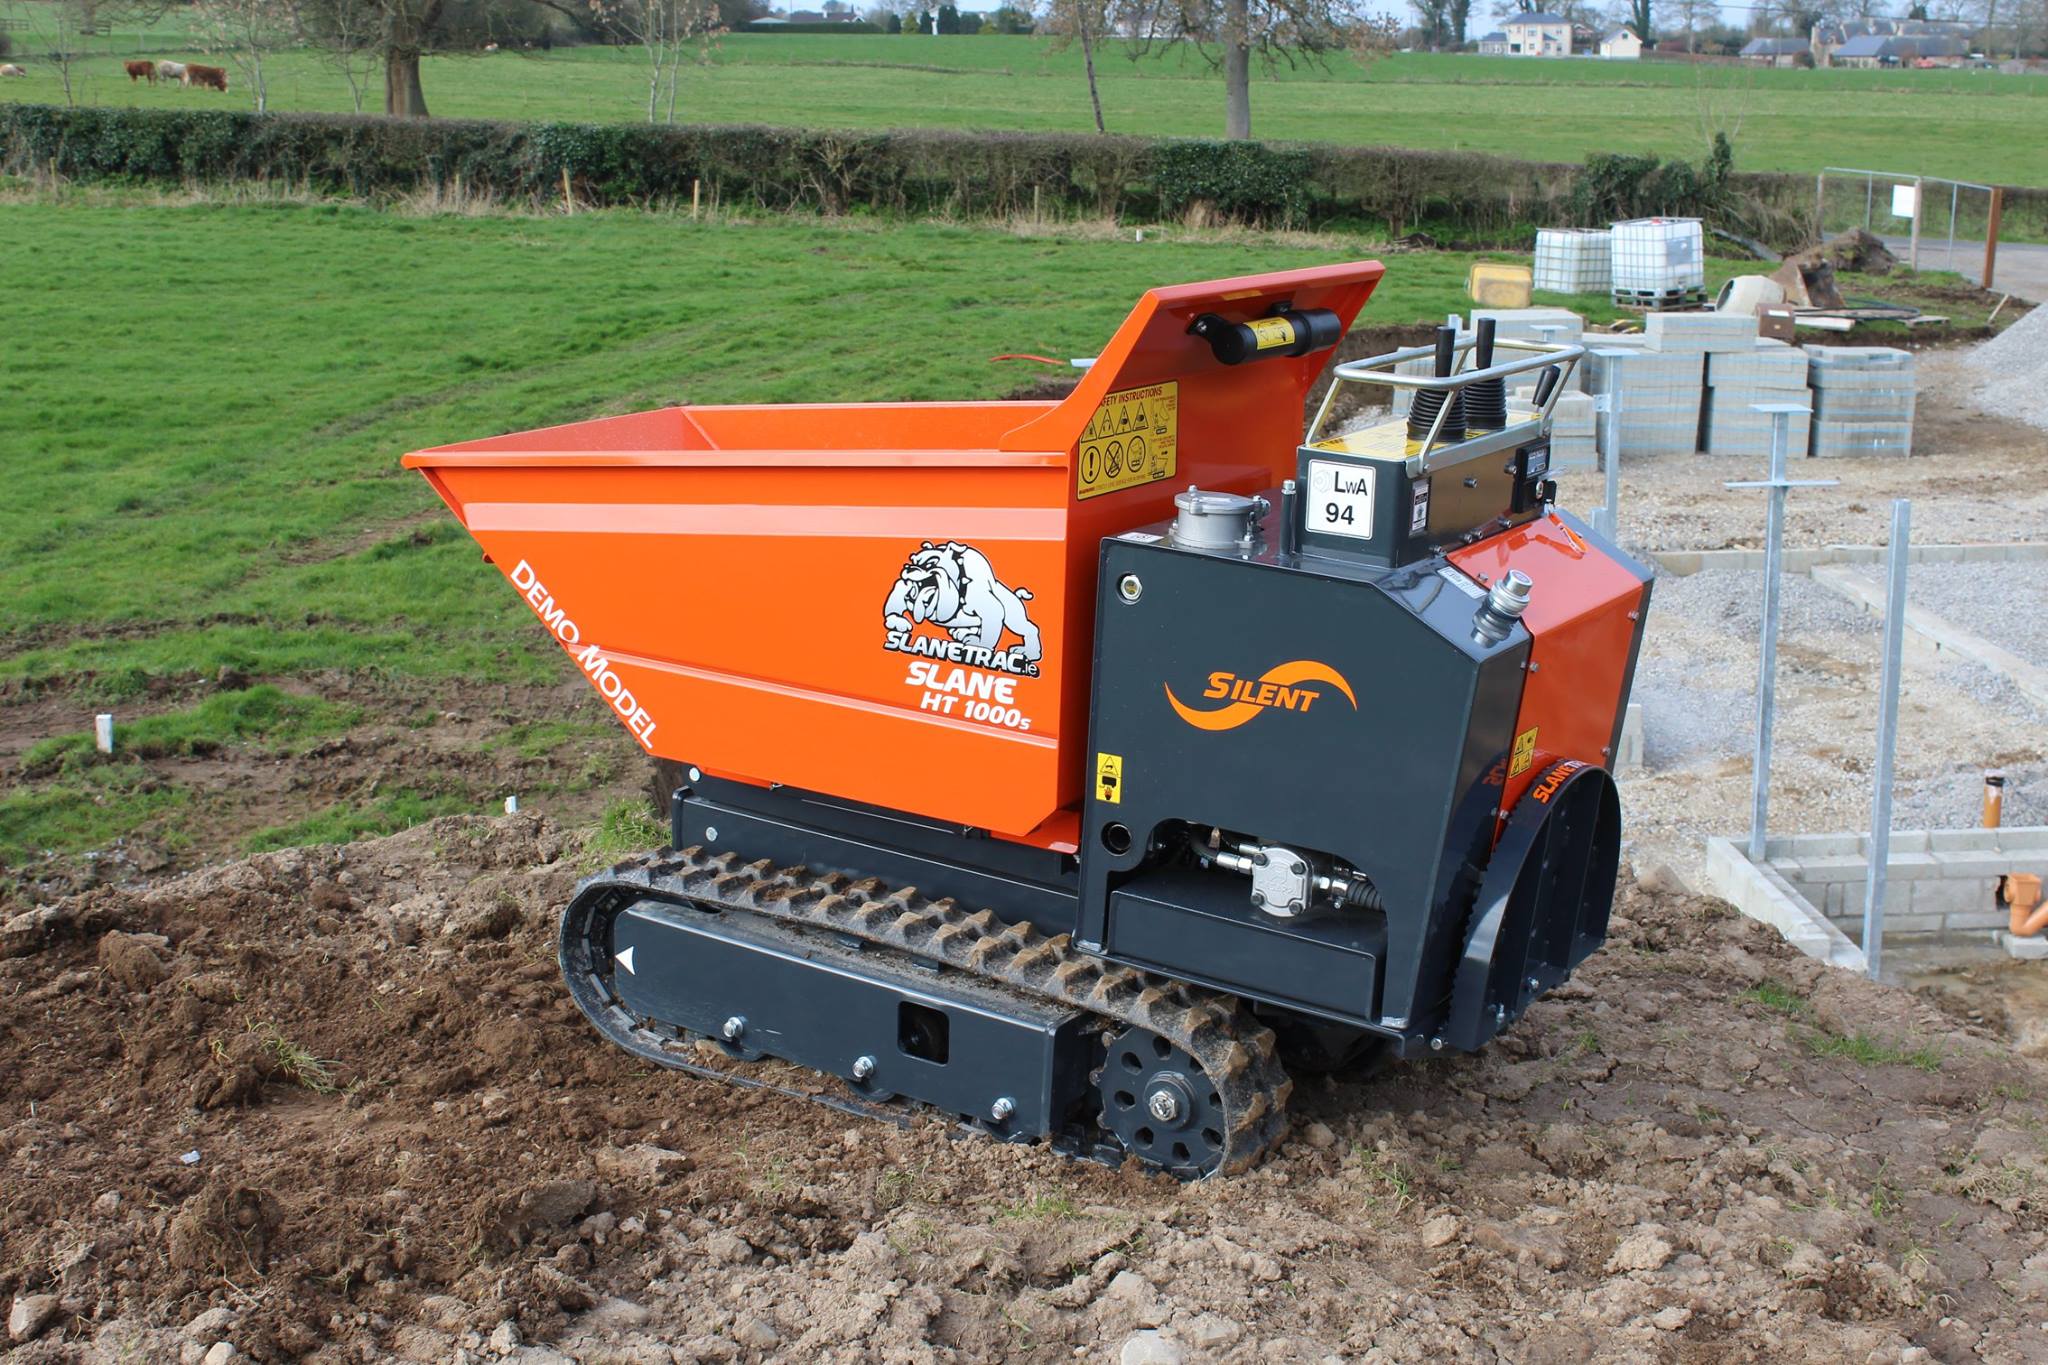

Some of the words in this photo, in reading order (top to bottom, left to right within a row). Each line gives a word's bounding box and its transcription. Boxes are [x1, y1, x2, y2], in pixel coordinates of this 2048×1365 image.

[1118, 386, 1163, 404] INSTRUCTIONS
[1325, 502, 1355, 525] 94
[510, 559, 579, 644] DEMO
[577, 645, 657, 749] MODEL
[884, 630, 1039, 676] SLANETRAC.ie
[905, 661, 1017, 705] SLANE
[920, 691, 959, 714] HT
[1203, 671, 1320, 712] SILENT
